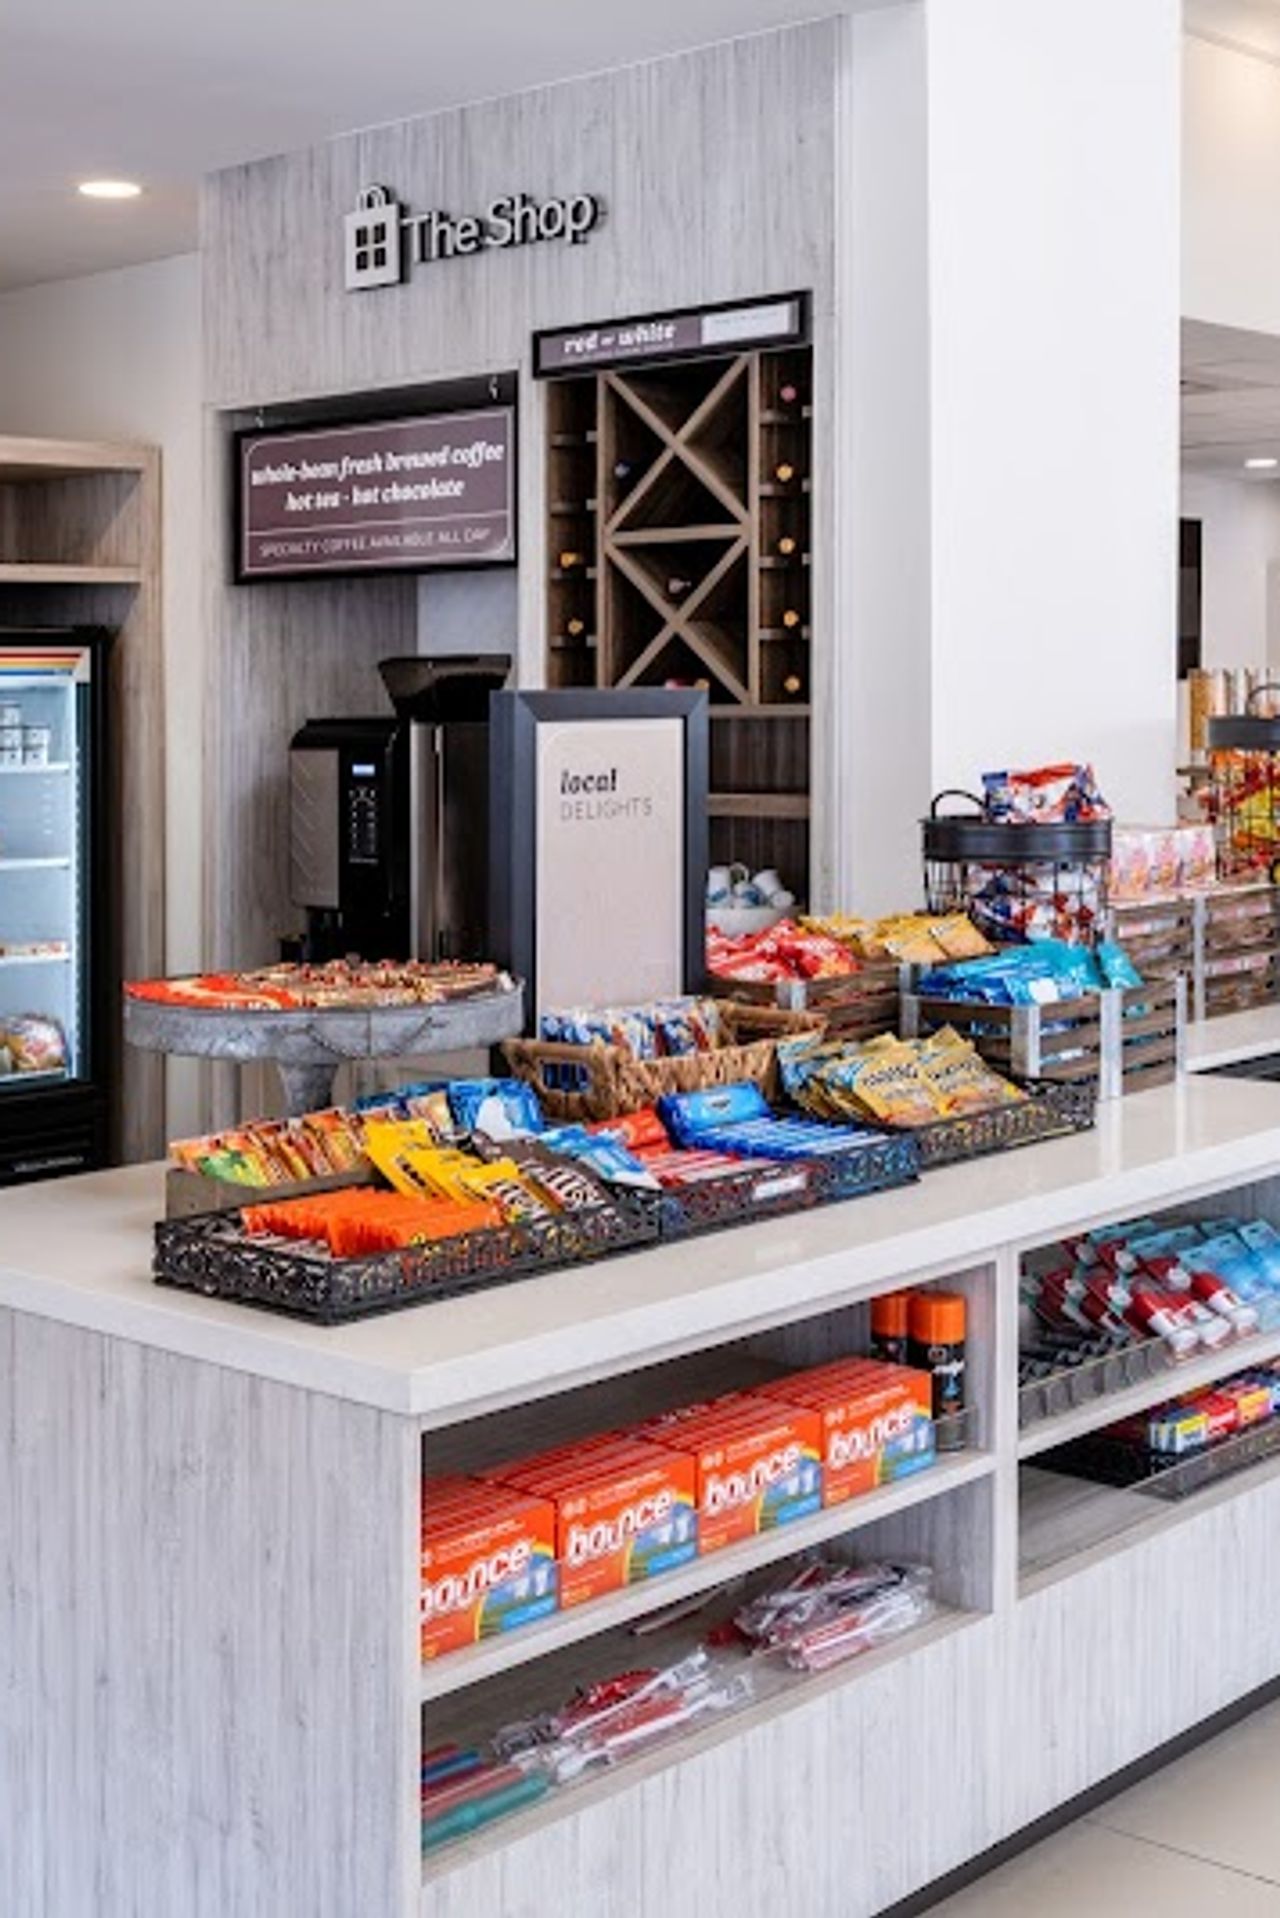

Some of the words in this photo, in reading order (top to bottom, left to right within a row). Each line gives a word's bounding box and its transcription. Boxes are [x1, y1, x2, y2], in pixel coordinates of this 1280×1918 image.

[401, 211, 480, 263] The
[486, 195, 600, 247] Shop
[564, 331, 598, 353] red
[618, 323, 676, 345] white
[338, 452, 382, 482] fresh
[452, 441, 504, 468] coffee
[381, 478, 465, 503] chocolate
[560, 767, 617, 794] local
[560, 797, 653, 820] DELIGHTS
[827, 1401, 917, 1471] bounce
[704, 1443, 801, 1516] bounce
[567, 1489, 672, 1566] bounce
